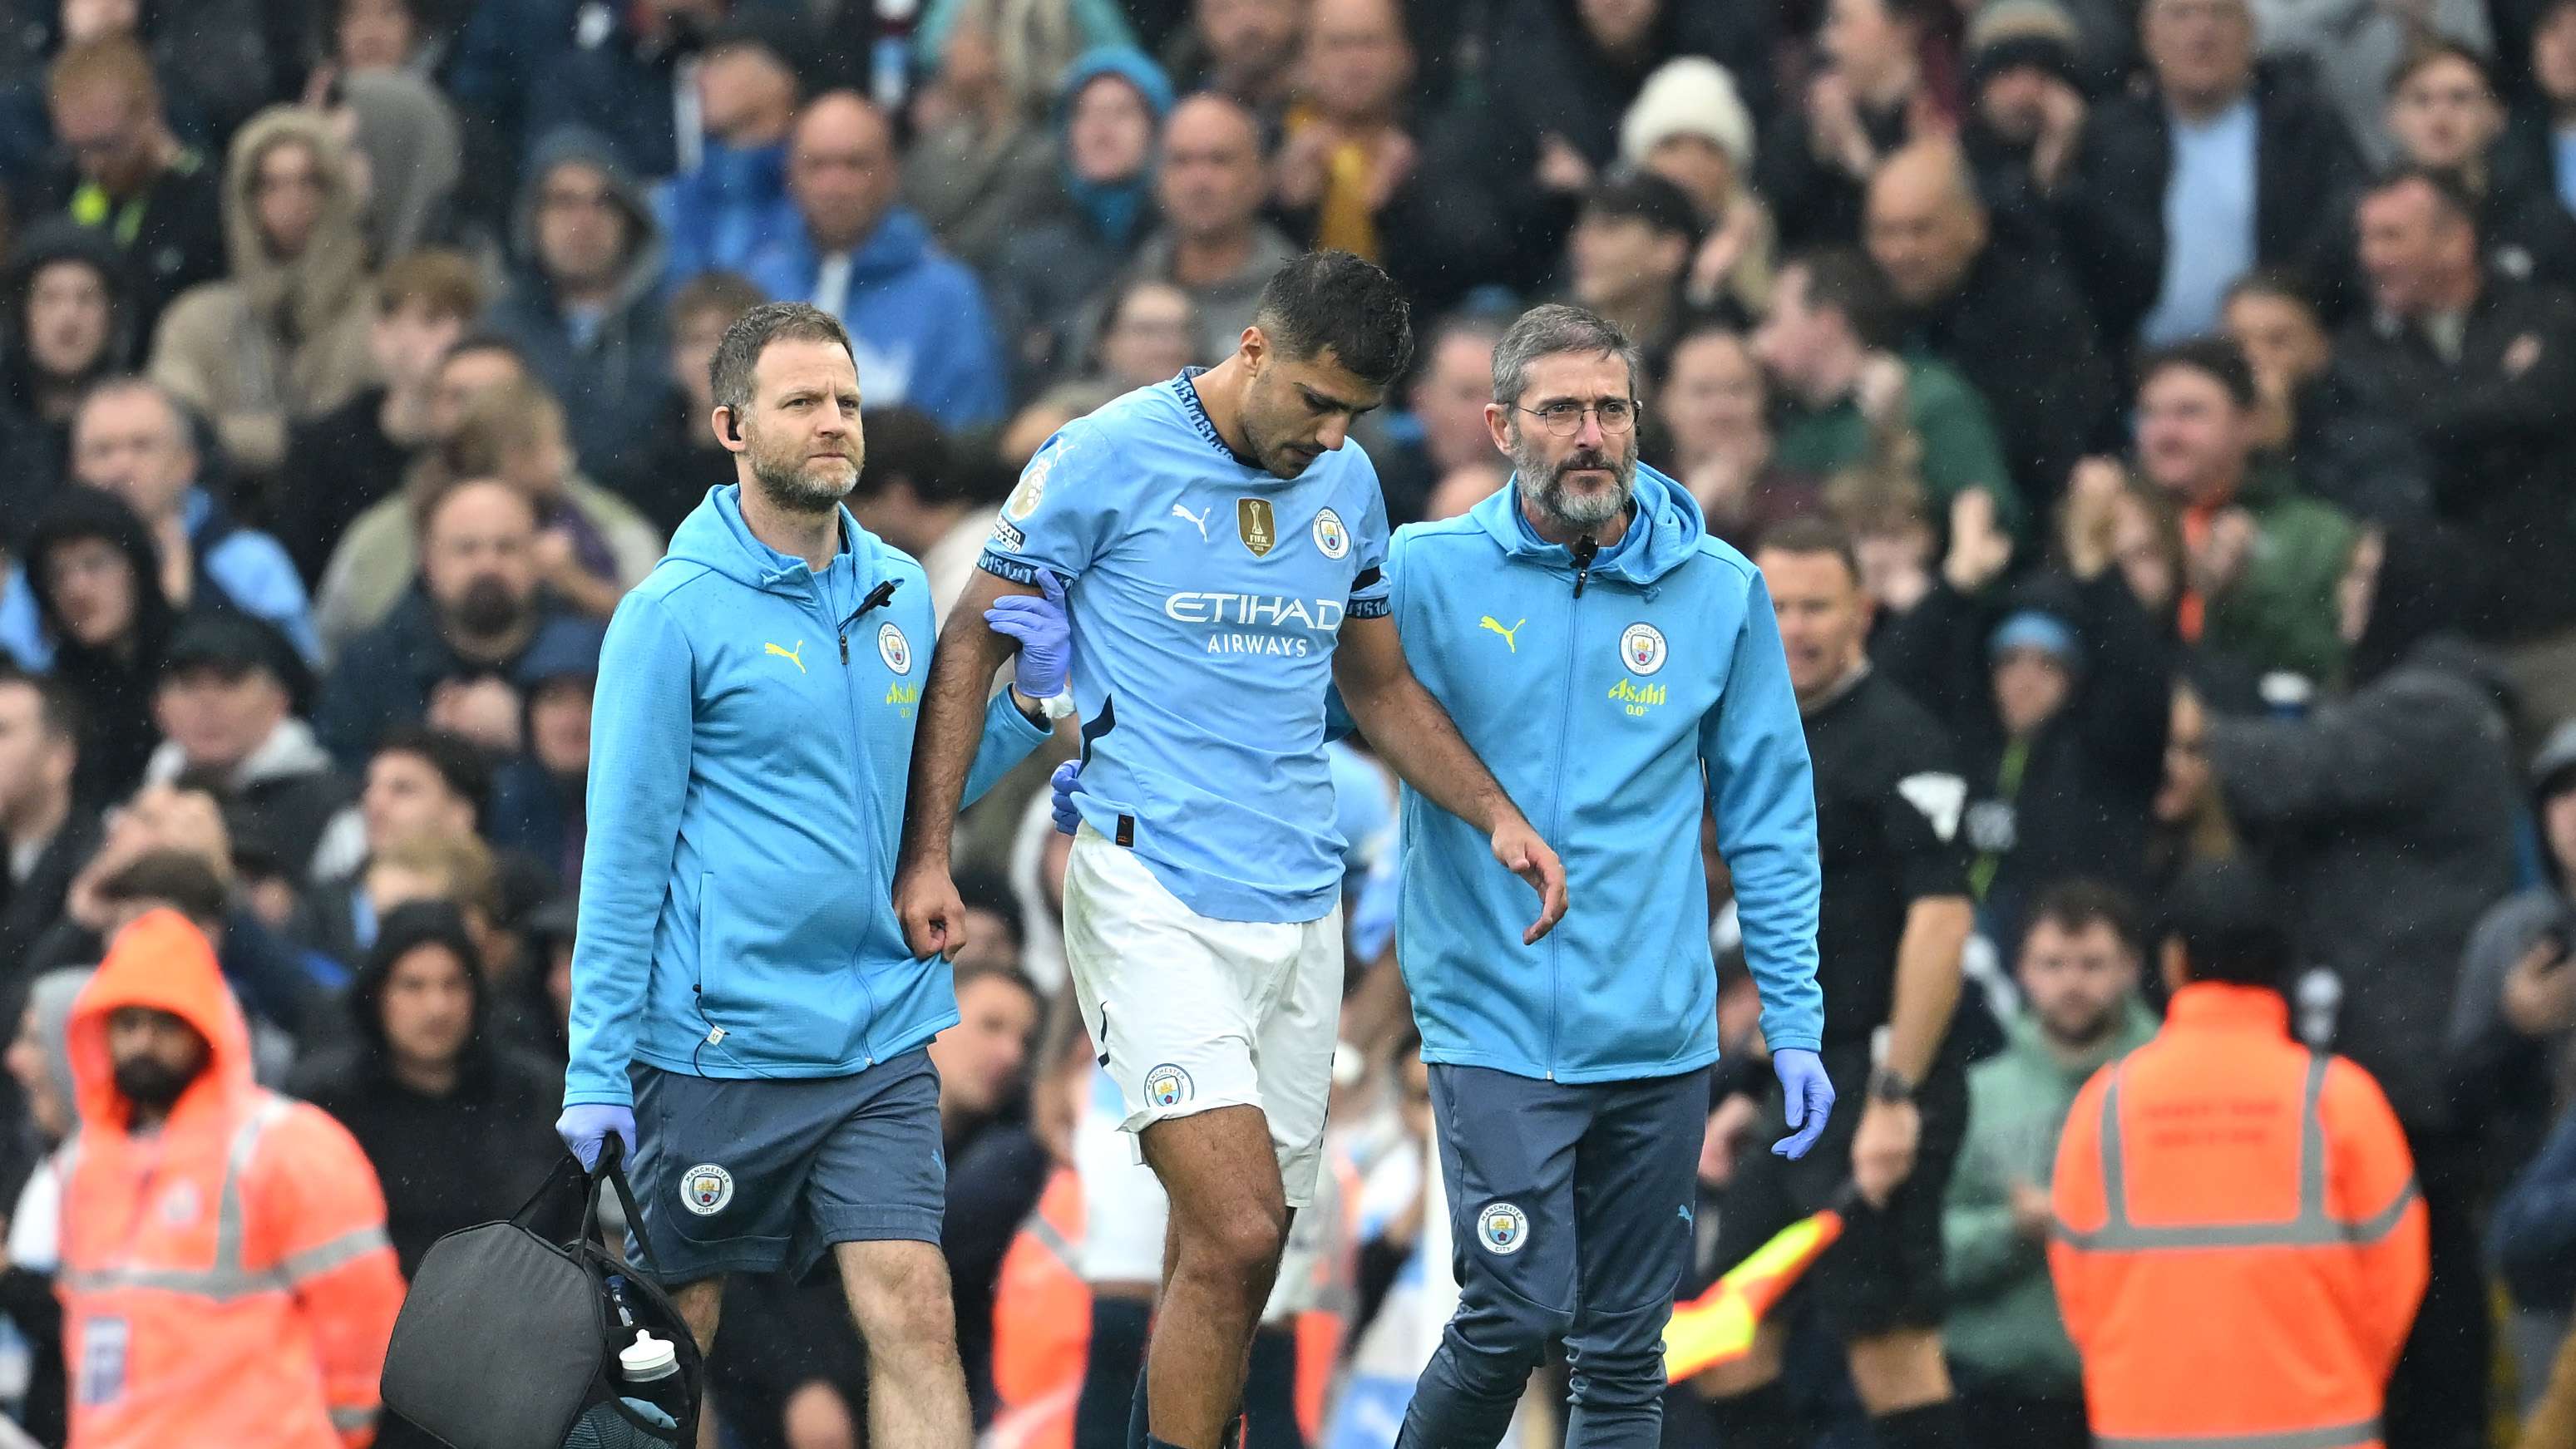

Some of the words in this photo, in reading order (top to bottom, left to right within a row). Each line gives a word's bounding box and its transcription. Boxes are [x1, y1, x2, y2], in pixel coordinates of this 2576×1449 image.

[1249, 534, 1267, 545] FIFA
[1165, 591, 1344, 630] ETIHAD
[1207, 633, 1307, 658] AIRWAYS
[1608, 678, 1666, 706] Asahi
[685, 1166, 730, 1184] MANCHESTER
[1481, 1205, 1523, 1222] MANCHESTER
